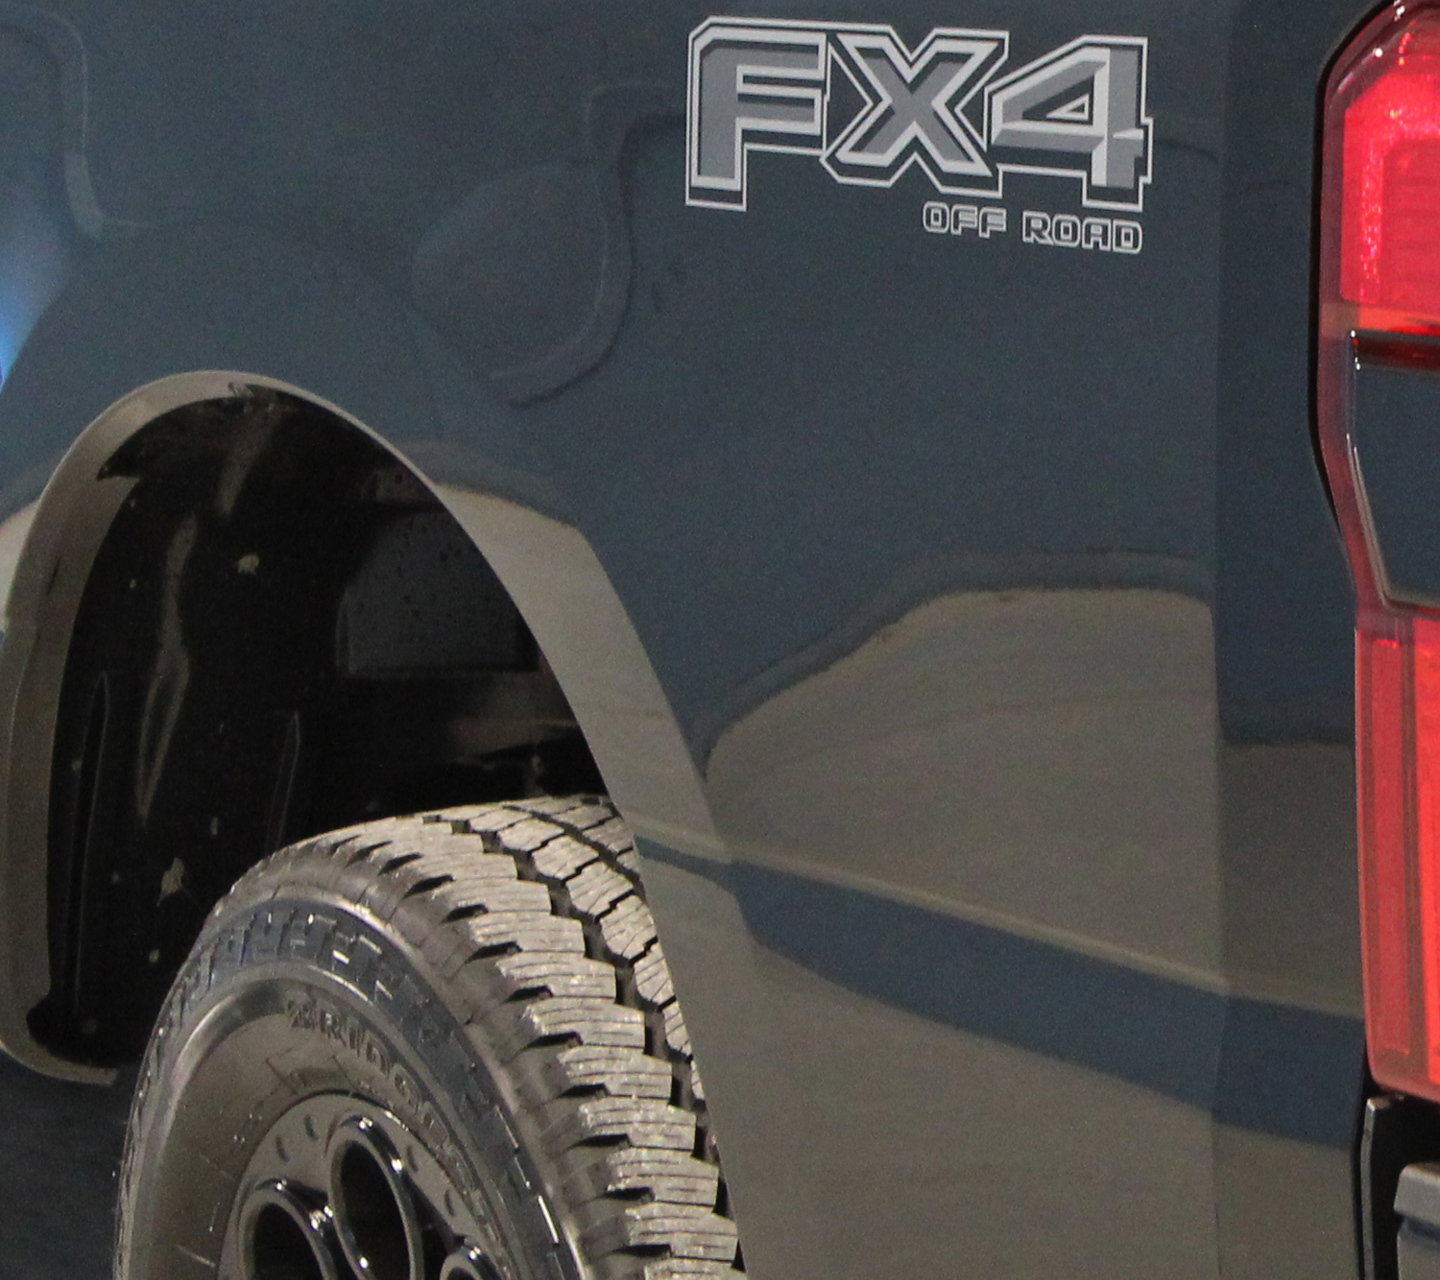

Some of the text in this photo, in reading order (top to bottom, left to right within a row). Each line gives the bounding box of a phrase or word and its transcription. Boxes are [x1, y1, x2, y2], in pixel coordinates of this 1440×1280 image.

[685, 16, 1153, 211] FX4
[923, 202, 1143, 253] OFF ROAD
